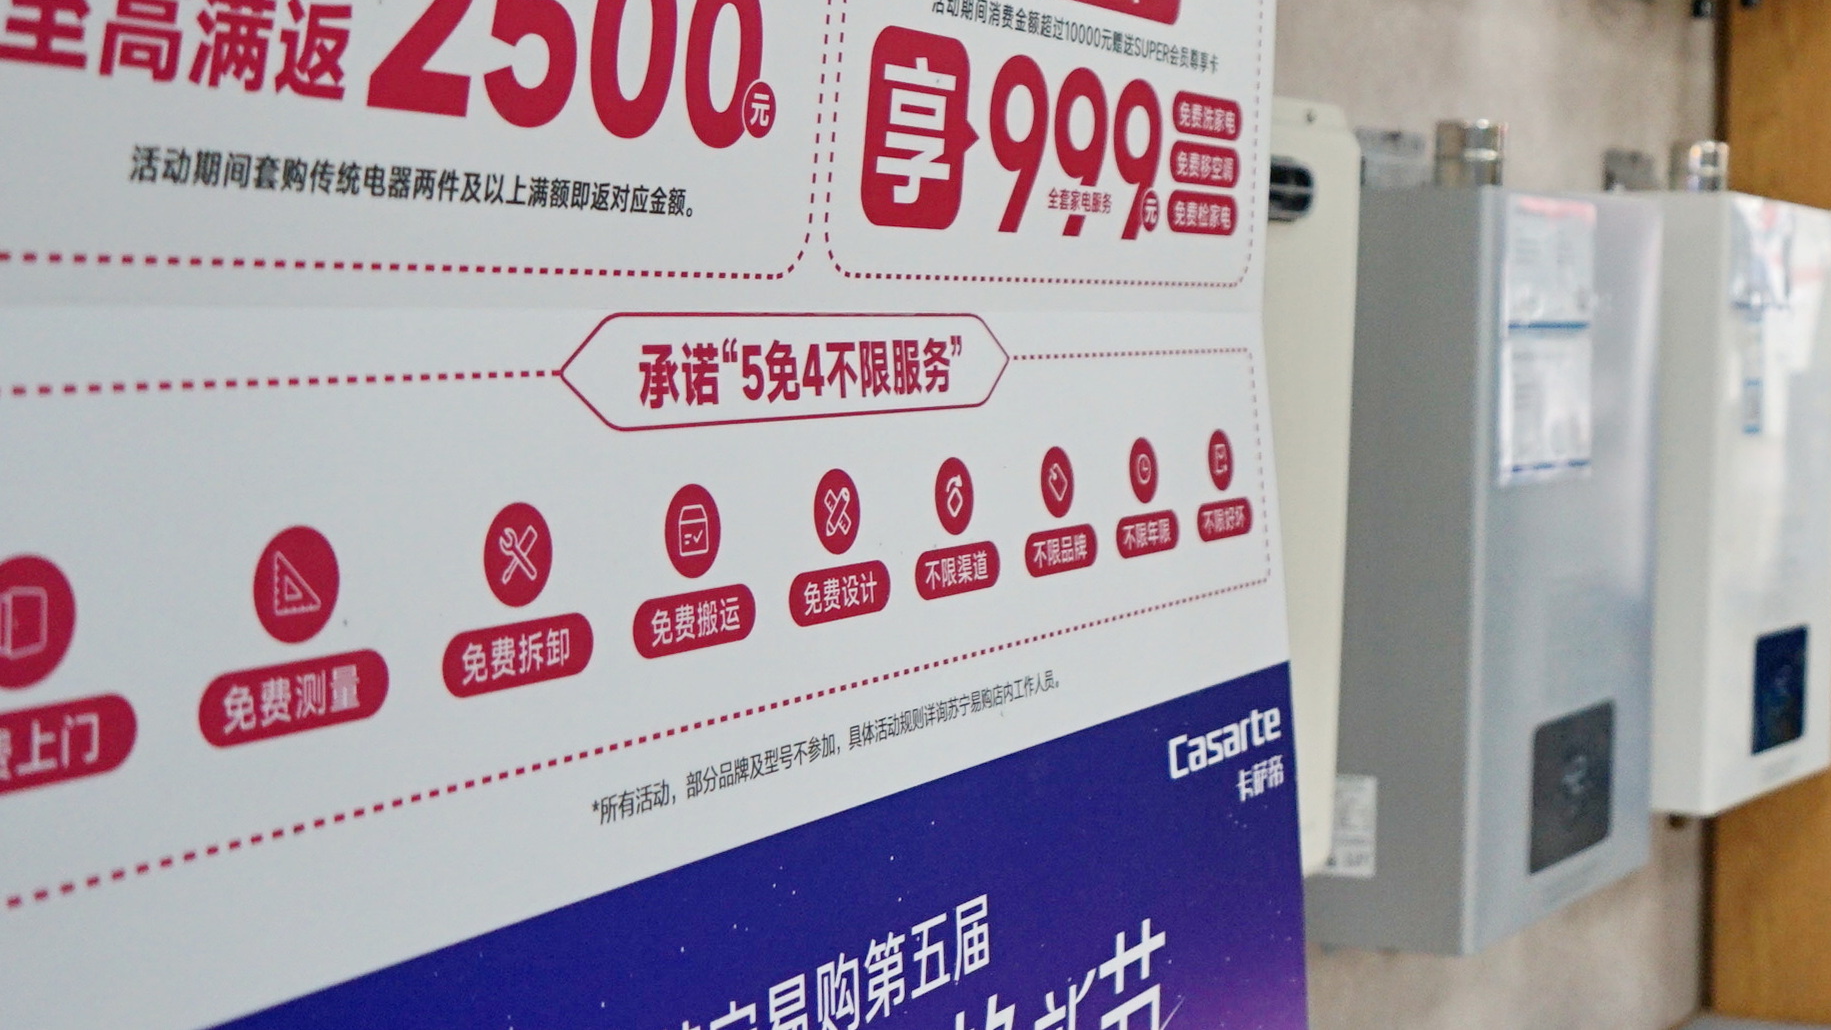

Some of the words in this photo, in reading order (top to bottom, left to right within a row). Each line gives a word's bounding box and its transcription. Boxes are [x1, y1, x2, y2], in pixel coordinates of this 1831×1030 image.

[750, 93, 772, 127] 元
[1178, 100, 1237, 135] 免费洗家电
[876, 56, 957, 207] 享
[988, 54, 1163, 240] 999
[127, 144, 694, 219] 活动期间套购传统电器两件及以上满额即返对应金额。
[1047, 186, 1114, 216] 全套家电服务
[1032, 531, 1088, 566] 不限品牌
[1122, 517, 1172, 550] 不限年限
[924, 550, 988, 590] 不限渠道
[802, 571, 878, 618] 免费设计
[650, 593, 741, 649] 免费搬运
[461, 628, 571, 685] 免费拆卸
[222, 665, 361, 736] 免费测量
[1167, 704, 1281, 780] Casarte
[1234, 755, 1284, 802] 卡萨帝
